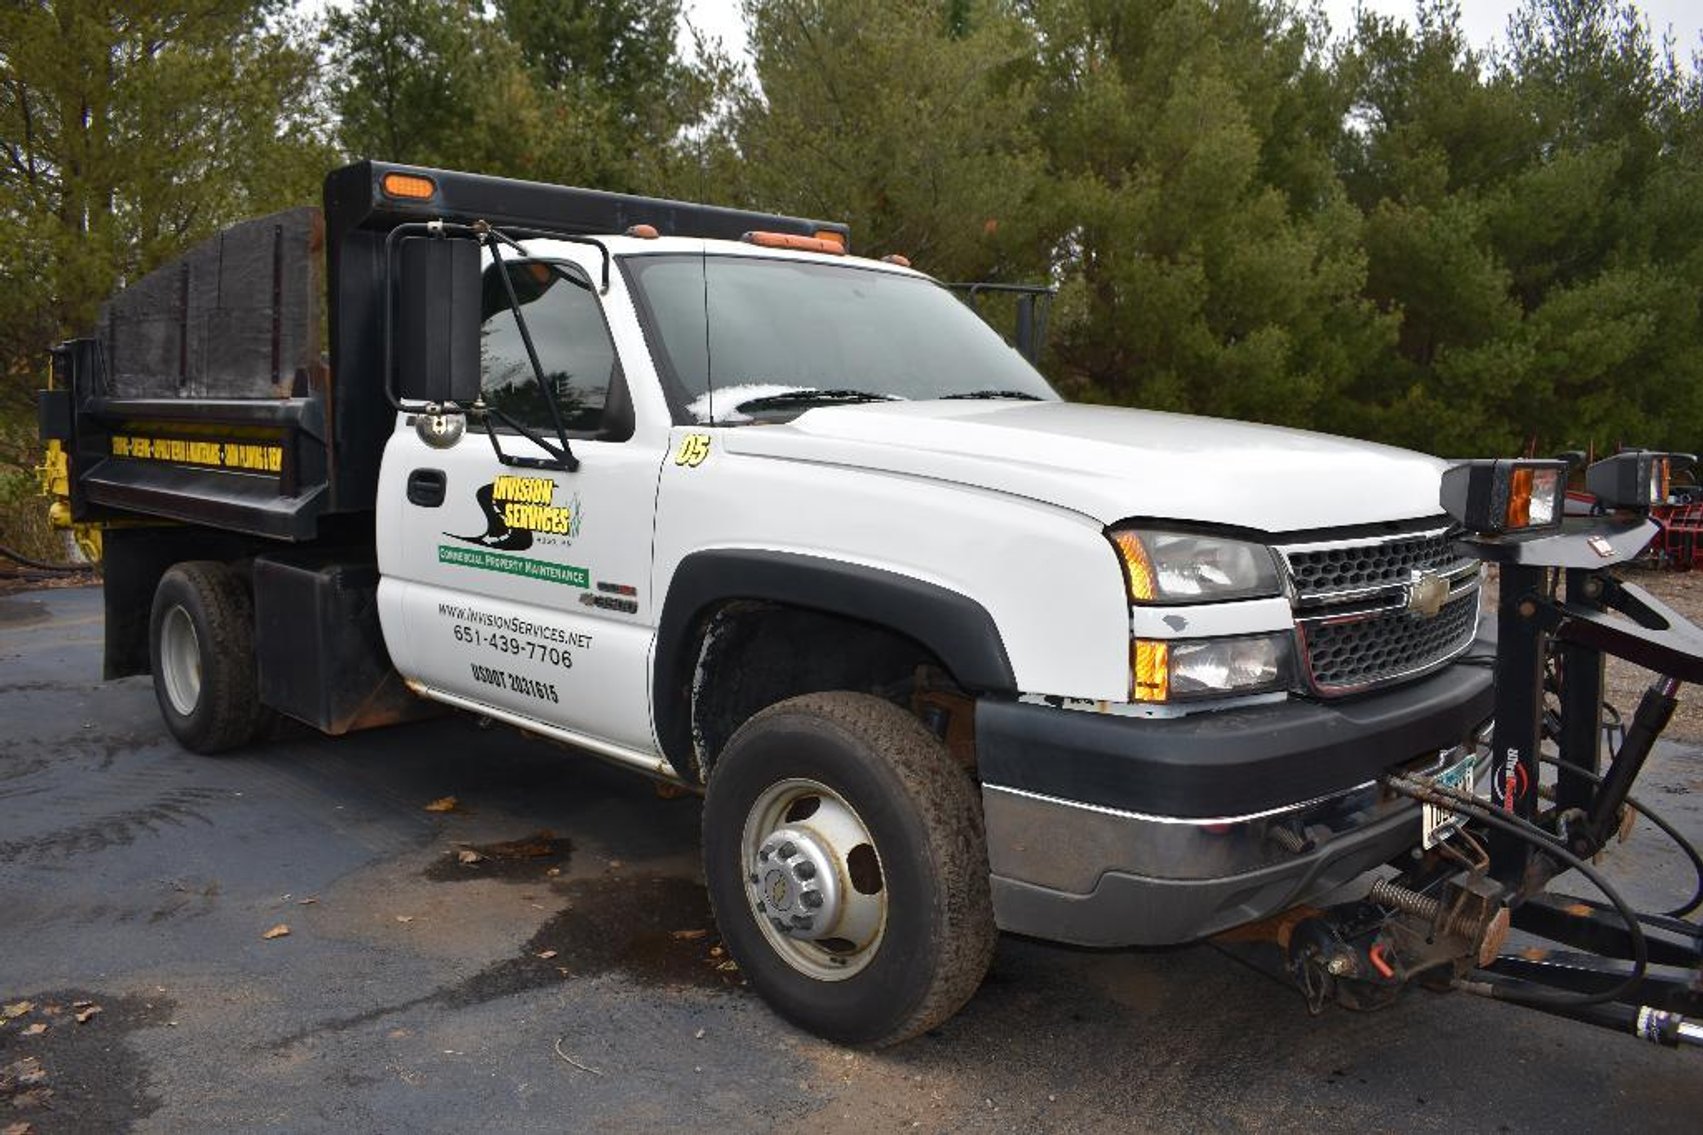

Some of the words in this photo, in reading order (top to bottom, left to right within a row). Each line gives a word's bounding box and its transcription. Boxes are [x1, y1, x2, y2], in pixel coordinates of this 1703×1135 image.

[675, 433, 711, 468] 05
[493, 474, 554, 505] INVISION
[504, 503, 570, 534] SERVICES
[440, 548, 482, 564] COMMERCIAL
[485, 555, 523, 571] PROPERTY
[525, 561, 585, 584] MAINTENANCE
[453, 625, 573, 668] 651-439-7706
[471, 663, 507, 689] USDOT
[509, 674, 560, 704] 2031615
